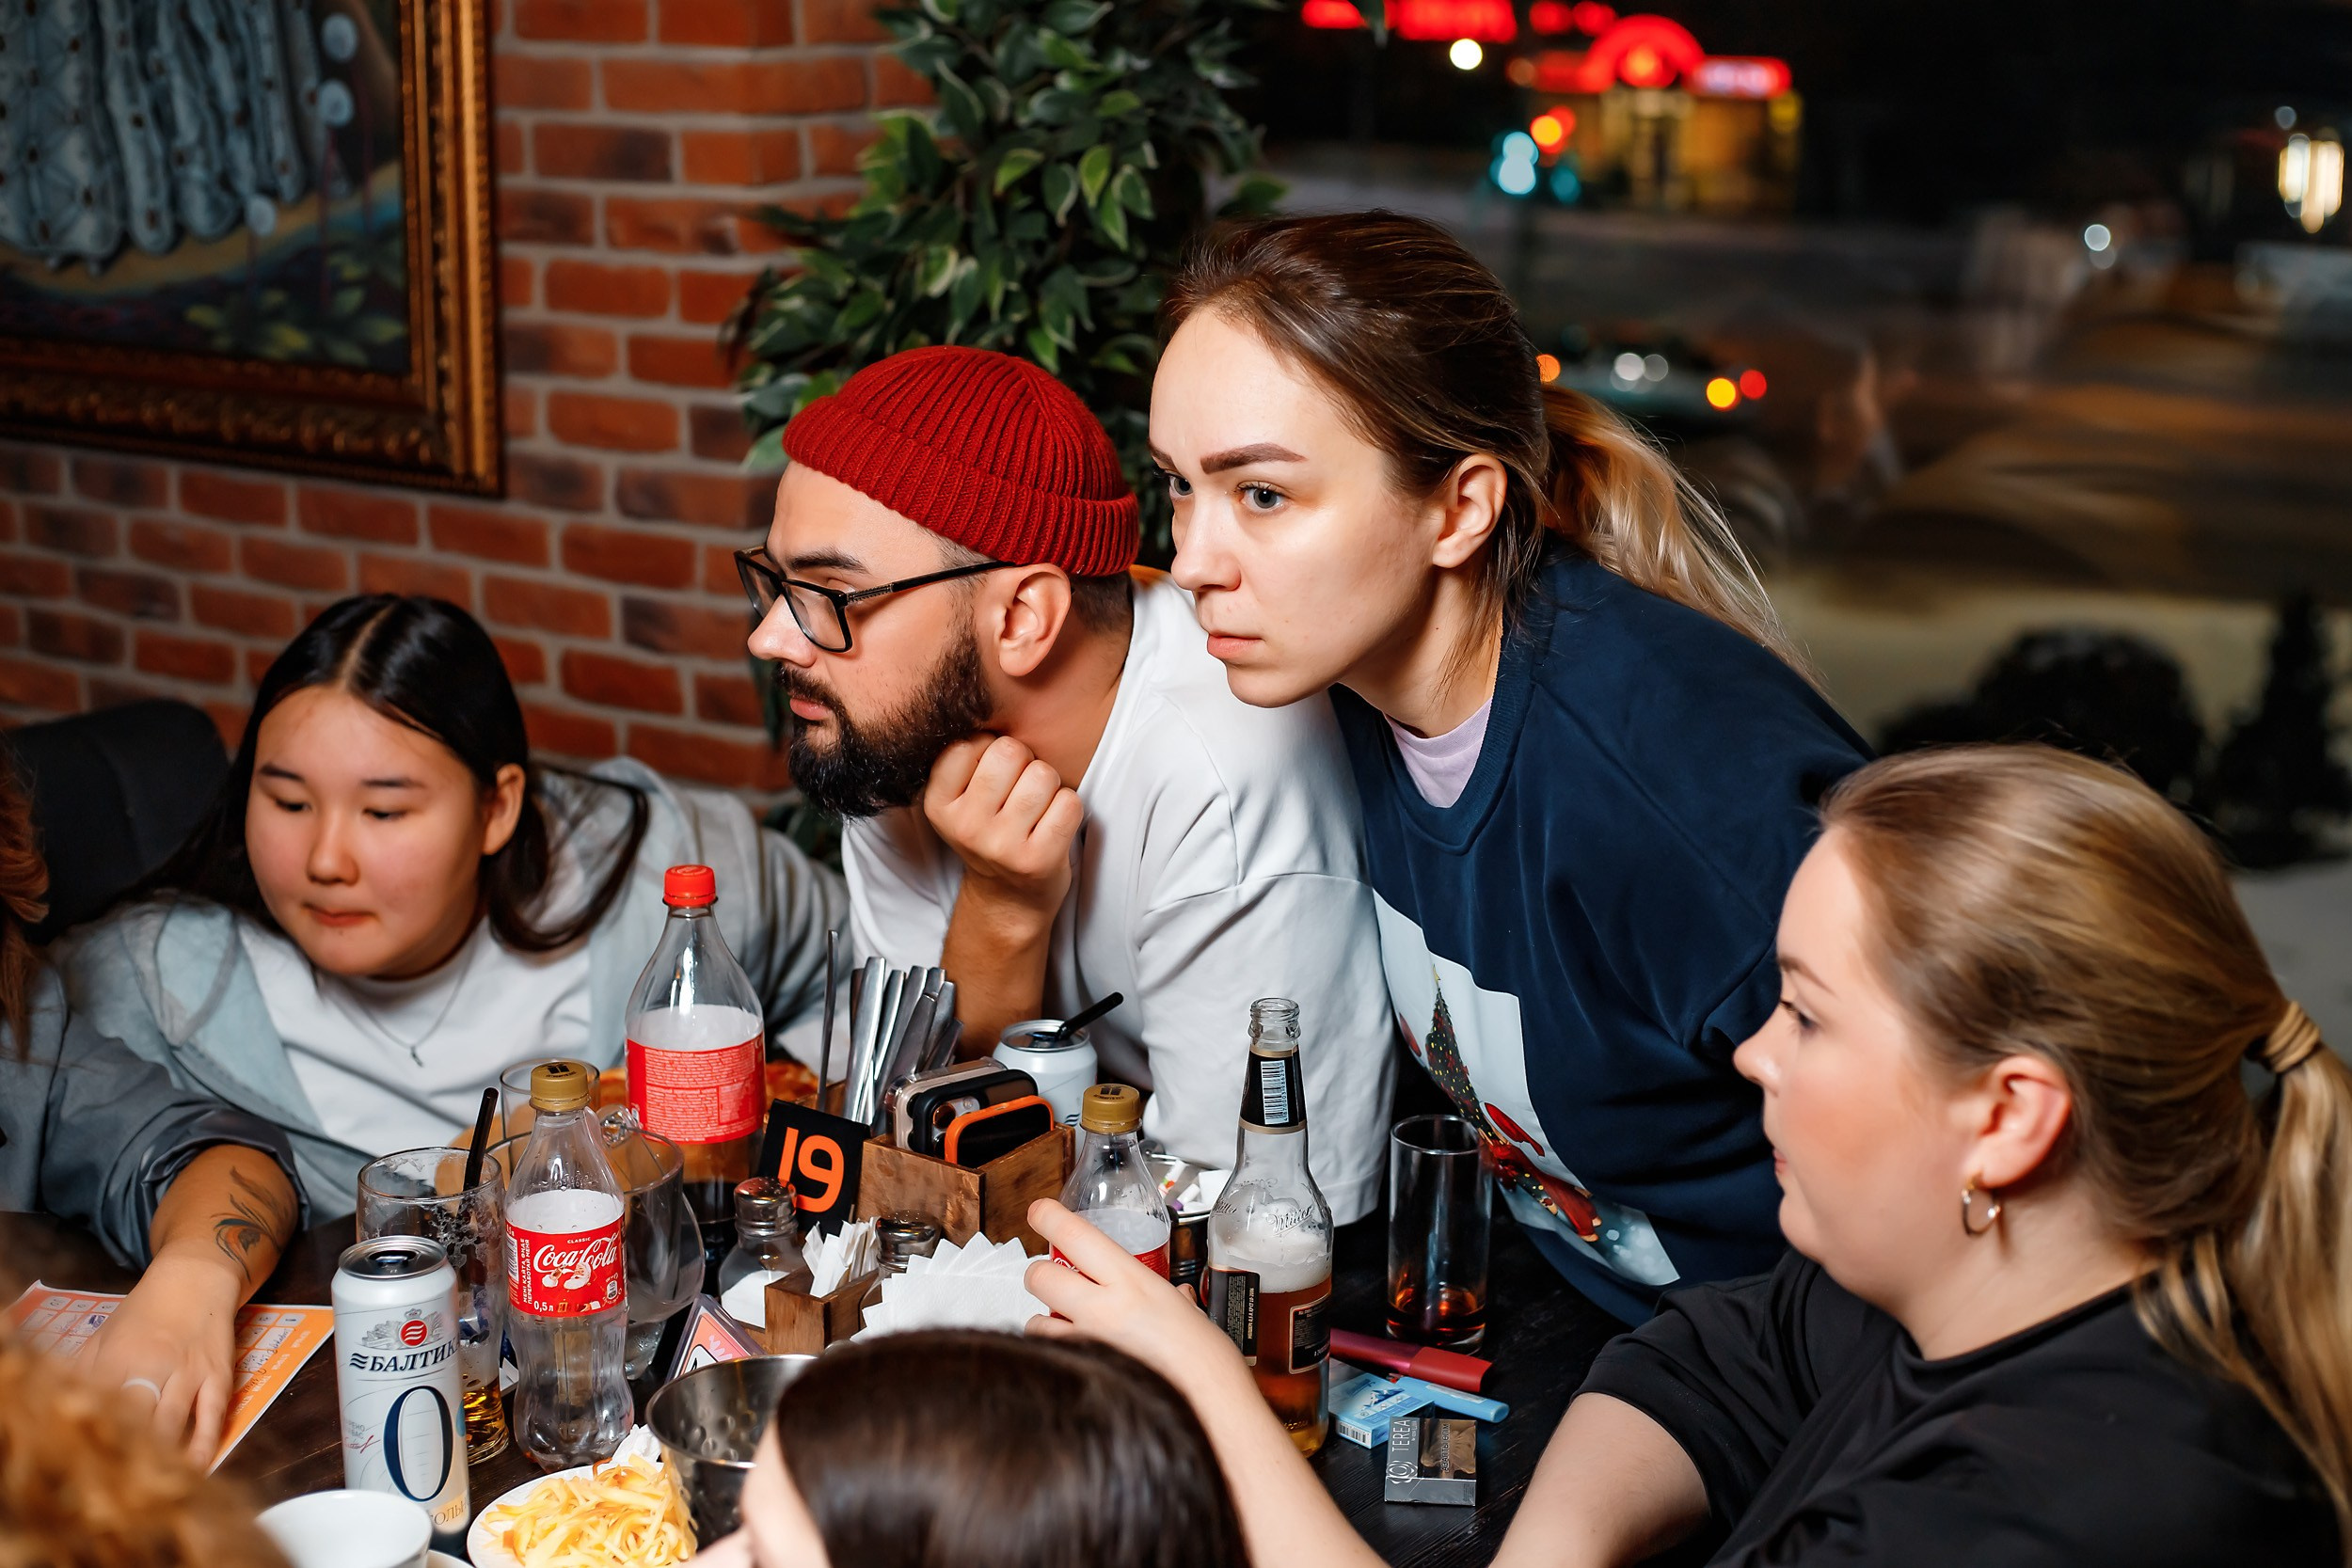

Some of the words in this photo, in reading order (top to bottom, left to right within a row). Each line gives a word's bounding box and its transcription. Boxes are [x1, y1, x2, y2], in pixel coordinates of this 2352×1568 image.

[777, 1127, 845, 1213] 19
[1265, 1204, 1315, 1235] Miller
[532, 1231, 619, 1274] Coca-Cola
[533, 1301, 548, 1312] 0,5
[368, 1337, 459, 1372] БАЛТИК
[383, 1385, 453, 1502] 0
[1391, 1419, 1410, 1452] TEREA
[1440, 1444, 1450, 1473] АЗАПТЫ
